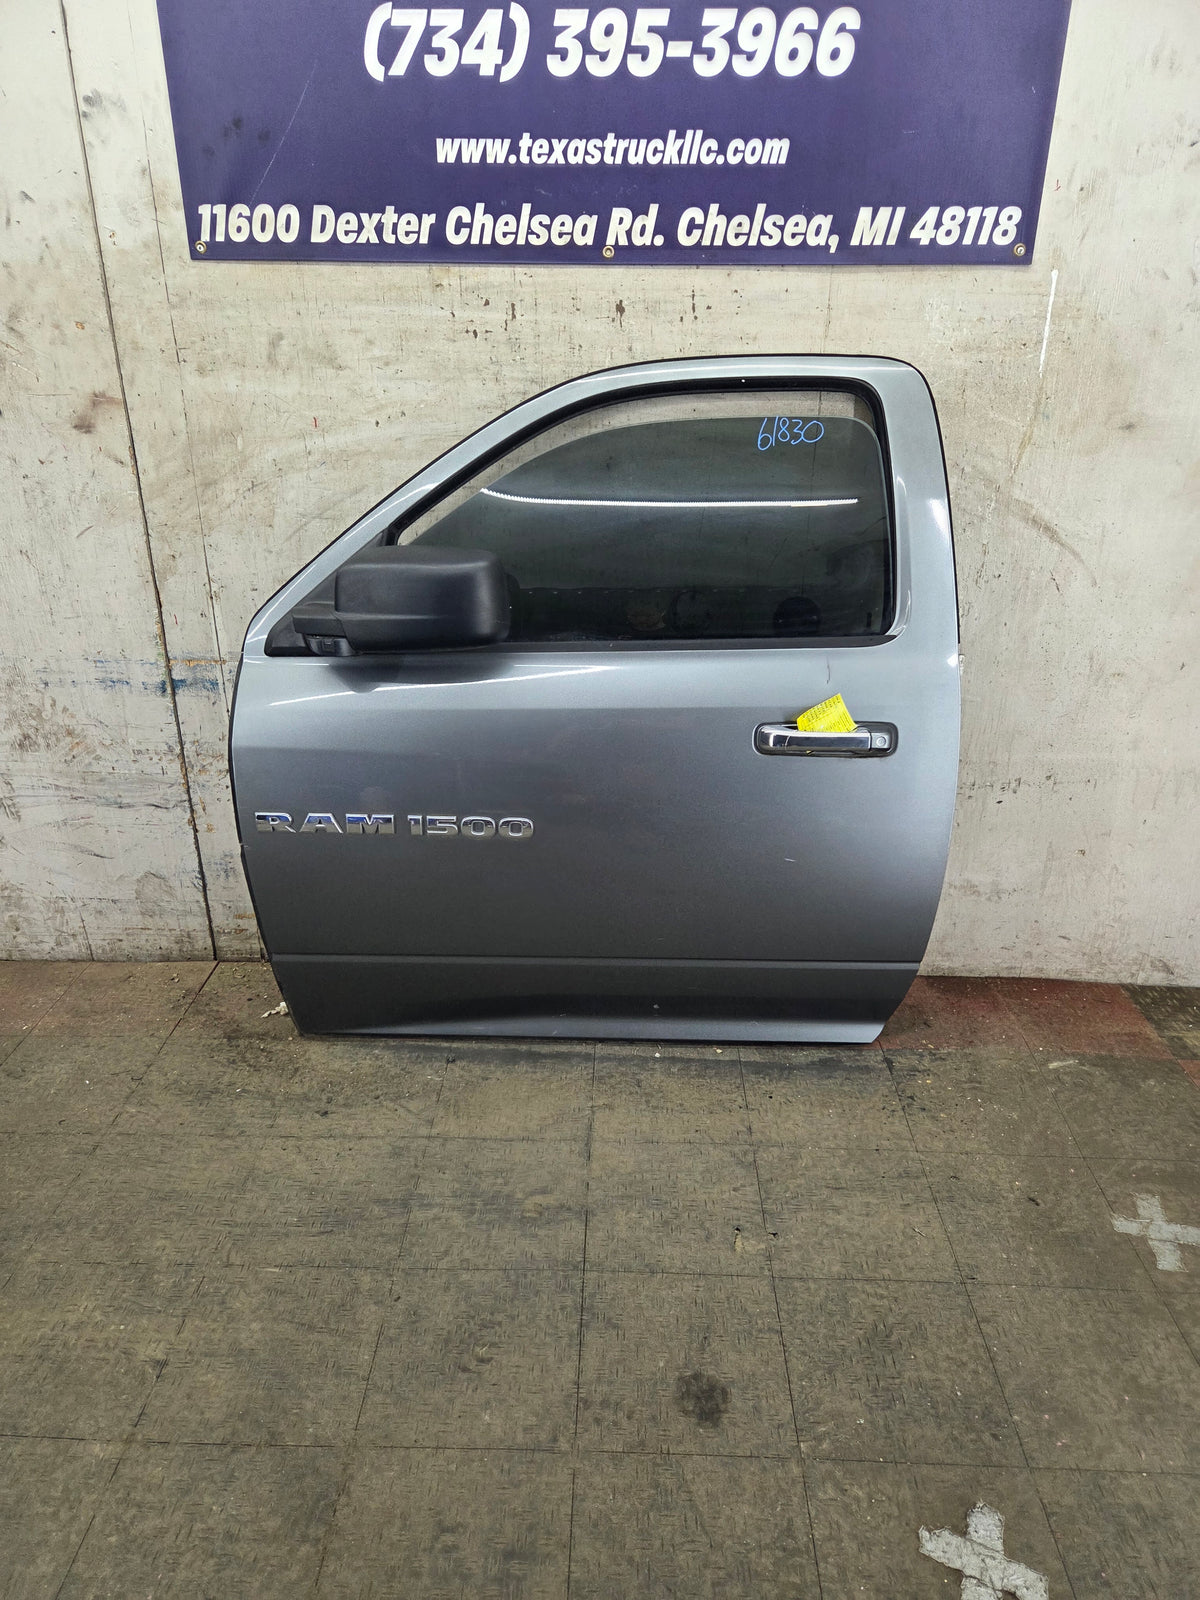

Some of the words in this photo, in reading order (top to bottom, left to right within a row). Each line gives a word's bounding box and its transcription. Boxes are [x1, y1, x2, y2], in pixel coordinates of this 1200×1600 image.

[363, 2, 530, 83] (734)
[546, 7, 861, 80] 395-3966
[436, 129, 790, 165] www.texastruckllc.com
[197, 204, 300, 244] 11600
[311, 205, 436, 245] Dexter
[446, 203, 598, 247] Chelsea
[606, 204, 664, 247] Rd.
[677, 203, 839, 253] Chelsea,
[850, 206, 906, 246] MI
[909, 206, 1022, 247] 48118
[758, 416, 824, 450] 61830
[254, 812, 395, 835] RAM
[407, 814, 534, 840] 1500
